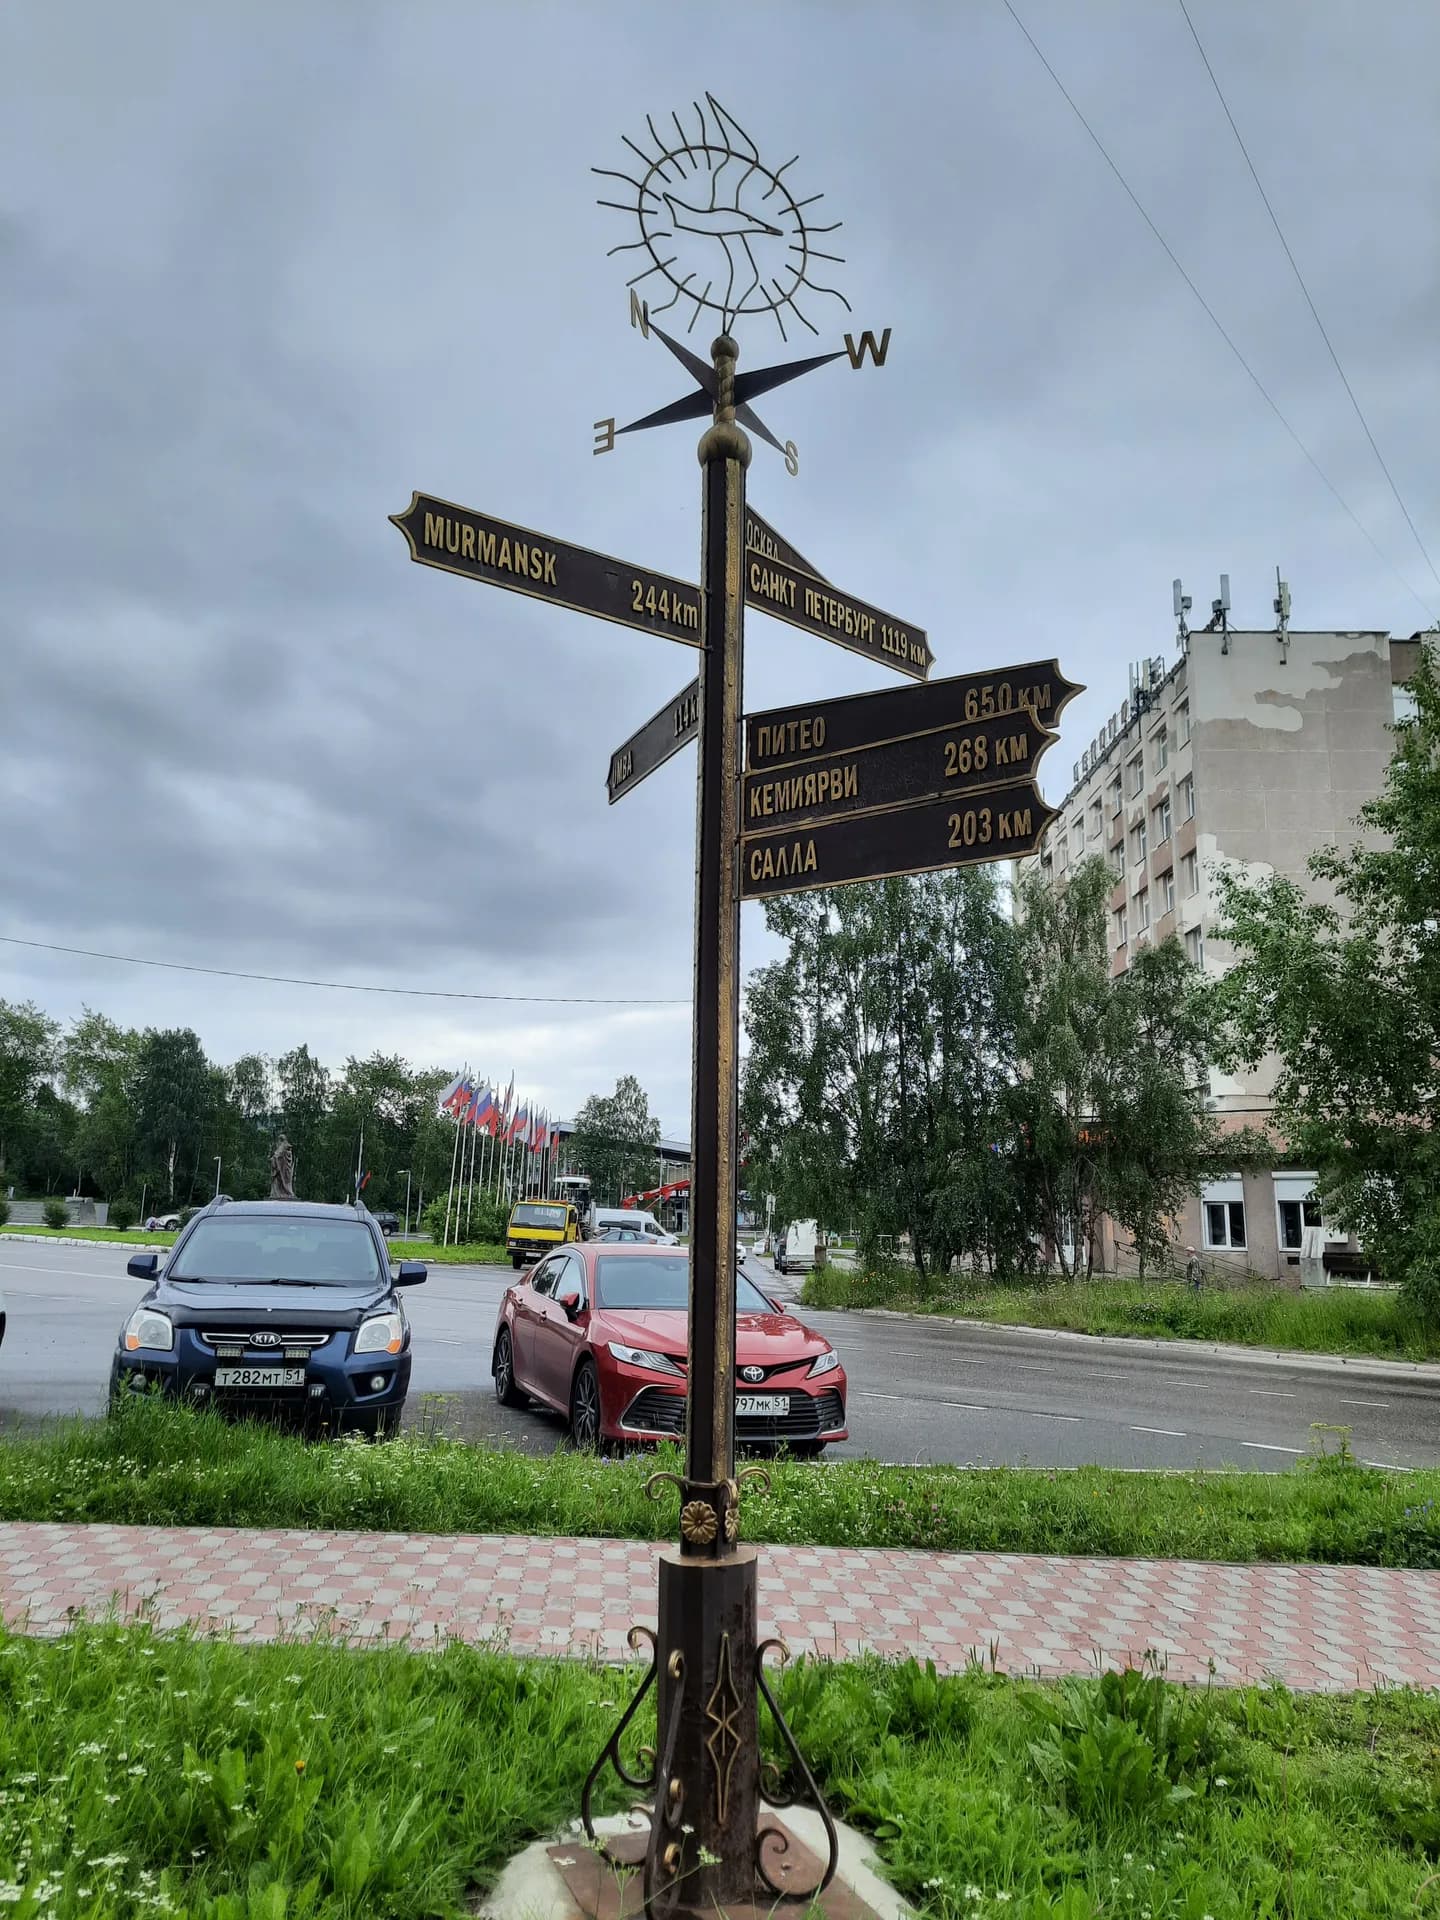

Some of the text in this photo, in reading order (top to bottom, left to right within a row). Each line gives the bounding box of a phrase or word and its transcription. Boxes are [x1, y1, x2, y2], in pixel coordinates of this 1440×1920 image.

[630, 287, 649, 340] N
[843, 328, 892, 370] W
[785, 440, 799, 477] S
[423, 512, 558, 586] MURMANSK
[746, 520, 780, 560] ОСКВА
[750, 563, 797, 608] САНКТ
[805, 588, 876, 643] ПЕТЕРБУРГ
[881, 624, 908, 659] 1119
[757, 716, 826, 758] ПИТЕО
[964, 682, 1013, 721] 650
[750, 765, 858, 818] КЕМИЯРВИ
[944, 735, 988, 776] 268
[750, 839, 818, 881] САЛЛА
[948, 808, 992, 848] 203
[254, 1333, 277, 1345] KIA
[736, 1398, 771, 1411] 797МК
